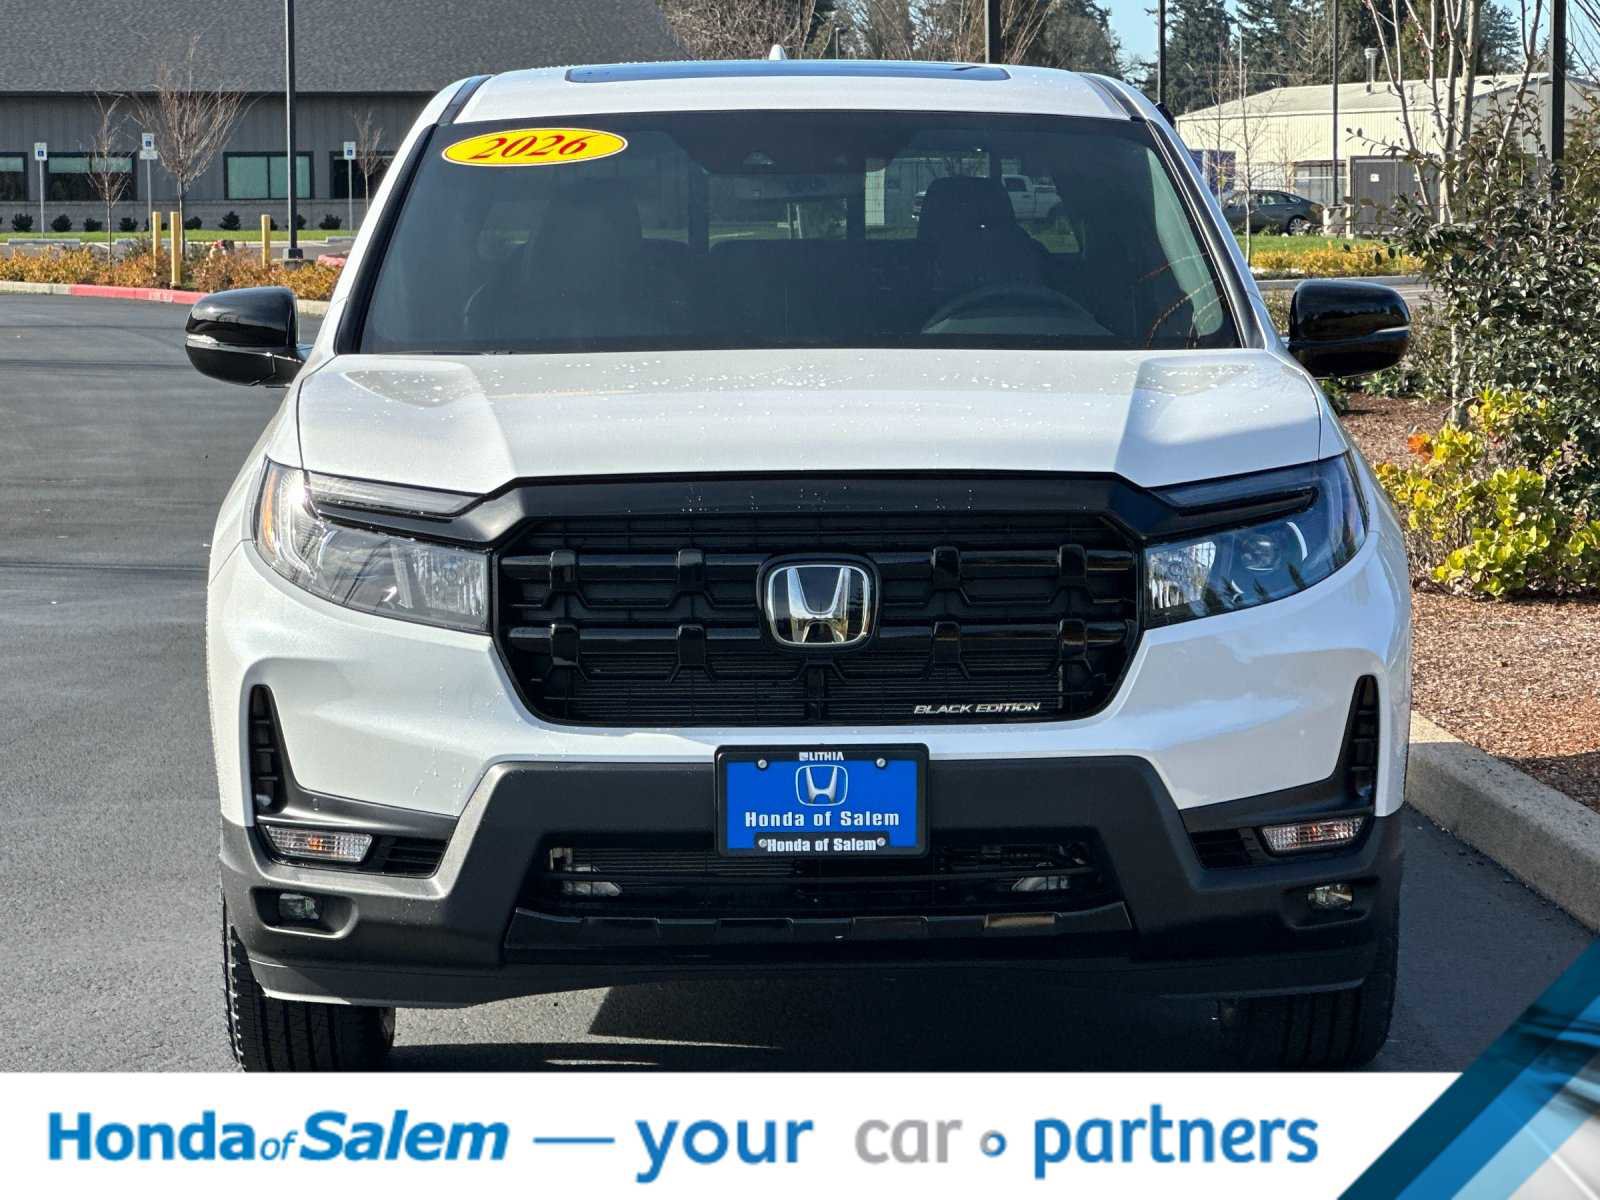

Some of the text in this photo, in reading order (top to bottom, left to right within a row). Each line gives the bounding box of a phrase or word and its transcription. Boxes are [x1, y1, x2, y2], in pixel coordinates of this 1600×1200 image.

[467, 134, 600, 160] 2026
[913, 701, 1042, 714] BLACK EDITION
[808, 752, 845, 761] LITHIA
[745, 811, 900, 827] Honda of Salem
[767, 838, 877, 852] Honda of Salem
